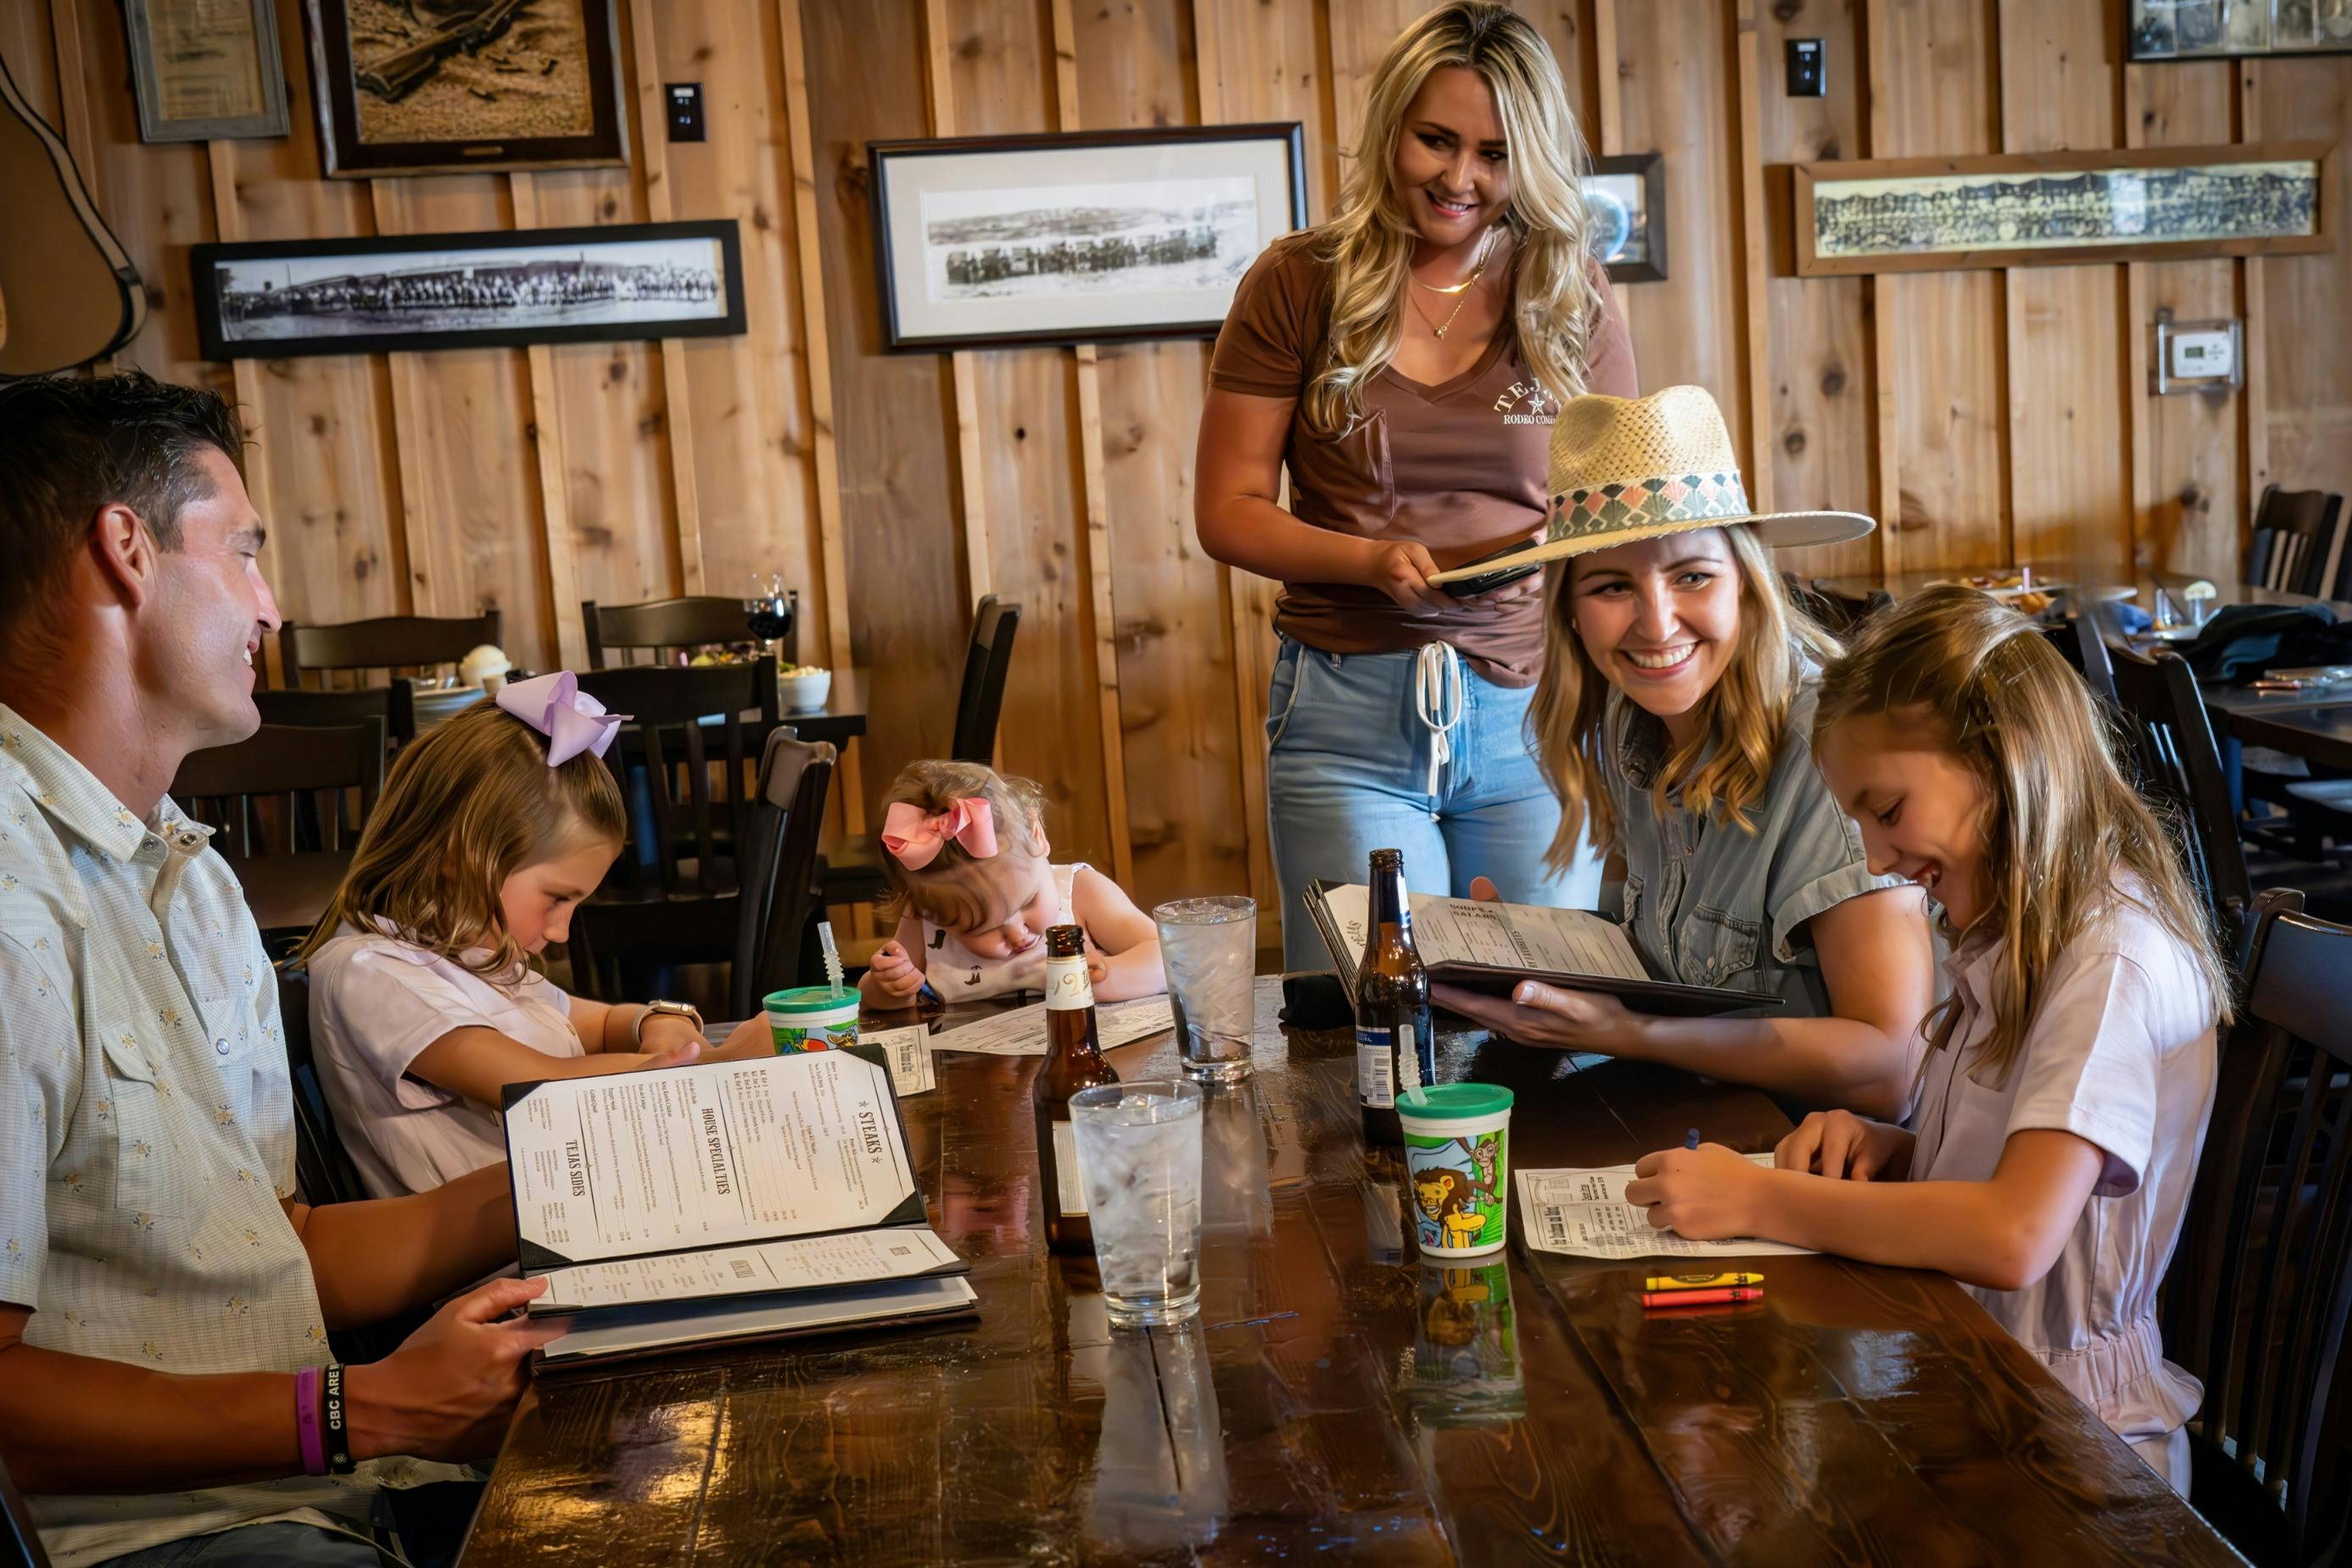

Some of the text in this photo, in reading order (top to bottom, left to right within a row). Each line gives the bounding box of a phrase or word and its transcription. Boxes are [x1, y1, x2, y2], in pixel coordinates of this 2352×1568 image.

[1494, 377, 1562, 414] TEJ
[1504, 414, 1534, 425] RODEO
[701, 1108, 730, 1194] HOUSE SPECIALTIES
[858, 1112, 882, 1153] STEAKS
[566, 1139, 585, 1197] TEJAS SIDES
[329, 1399, 341, 1430] CBC
